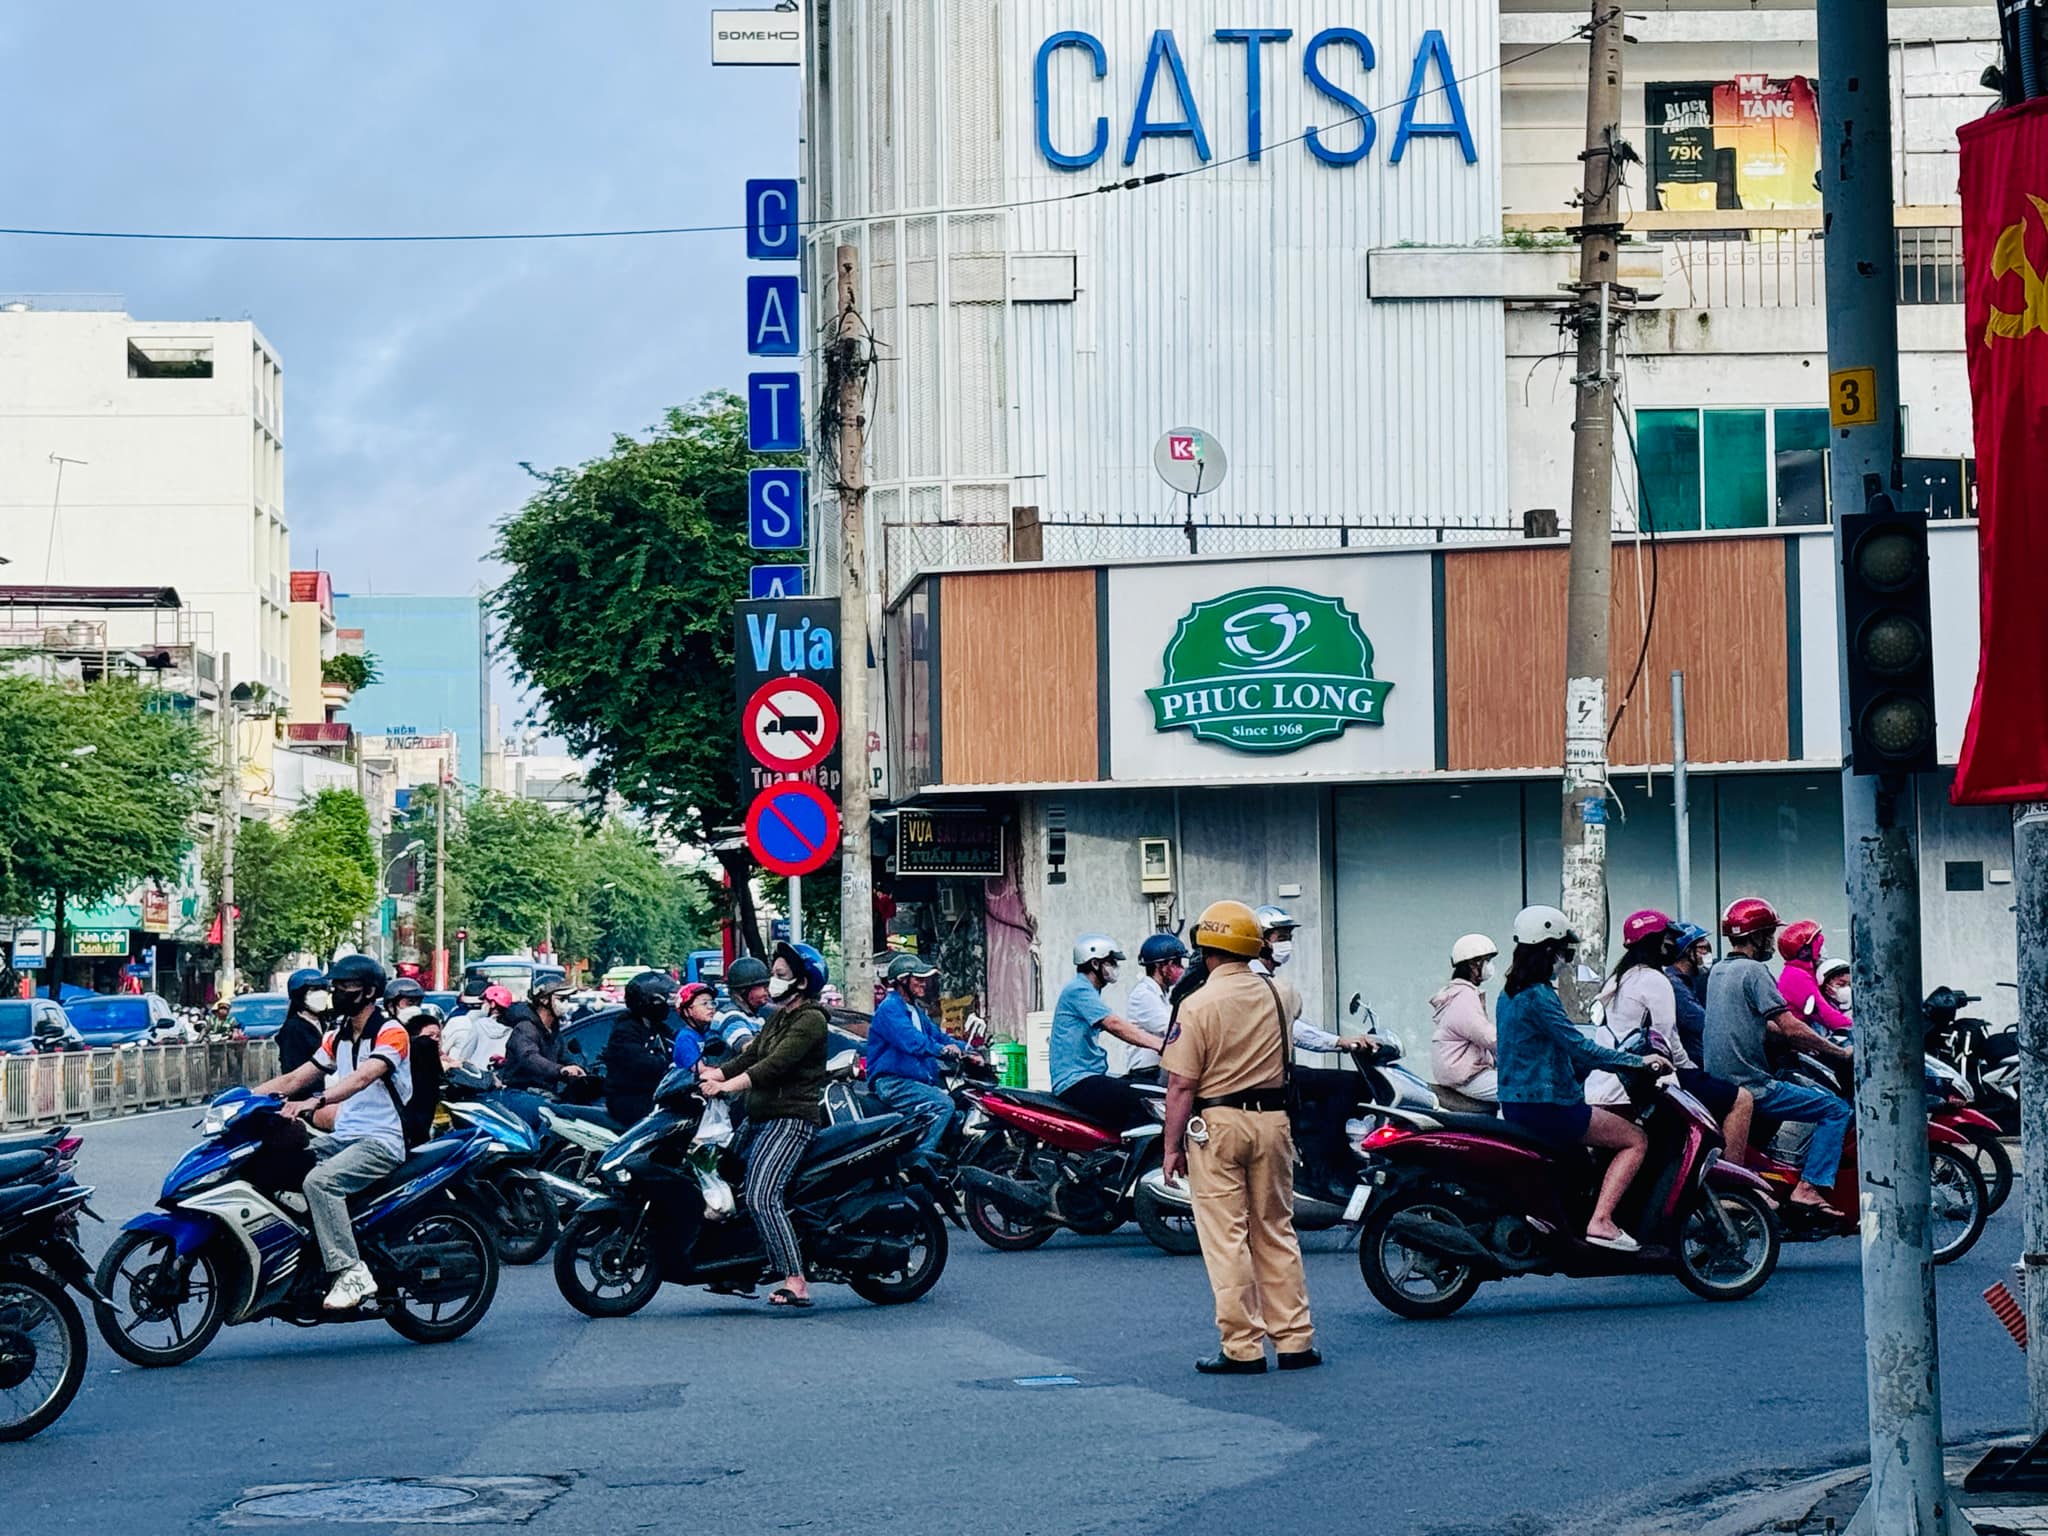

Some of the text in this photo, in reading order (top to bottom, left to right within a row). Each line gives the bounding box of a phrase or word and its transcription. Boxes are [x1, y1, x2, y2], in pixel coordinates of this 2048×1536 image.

[1035, 27, 1477, 169] CATSA
[1664, 99, 1708, 121] BLACK
[1662, 112, 1711, 135] FRIDAY
[1668, 146, 1703, 161] 79K
[1841, 379, 1860, 416] 3
[1160, 684, 1375, 720] PHUC LONG
[1232, 723, 1303, 737] Since 1968
